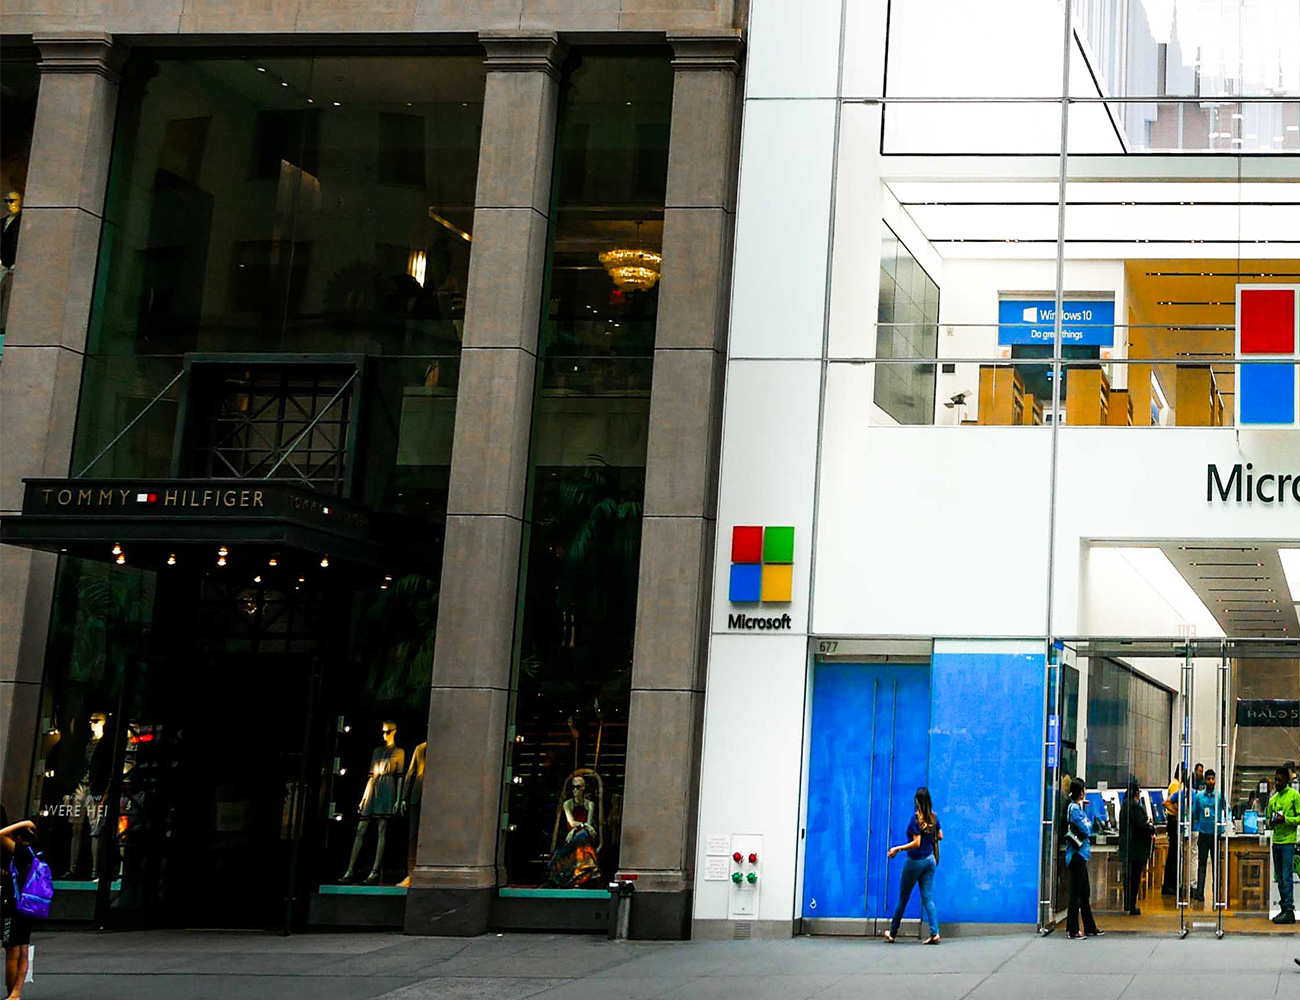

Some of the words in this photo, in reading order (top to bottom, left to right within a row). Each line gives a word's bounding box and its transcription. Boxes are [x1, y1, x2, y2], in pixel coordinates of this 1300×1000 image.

[1040, 310, 1081, 321] Winows
[1031, 330, 1041, 339] Do
[1043, 330, 1060, 341] gre
[41, 488, 131, 507] TOMMY
[164, 489, 265, 508] HILFIGER
[728, 613, 792, 629] Microsoft
[819, 641, 838, 652] 677
[1246, 709, 1288, 719] HALO
[1291, 709, 1300, 719] 5
[44, 804, 82, 818] WERE
[86, 804, 109, 818] HE
